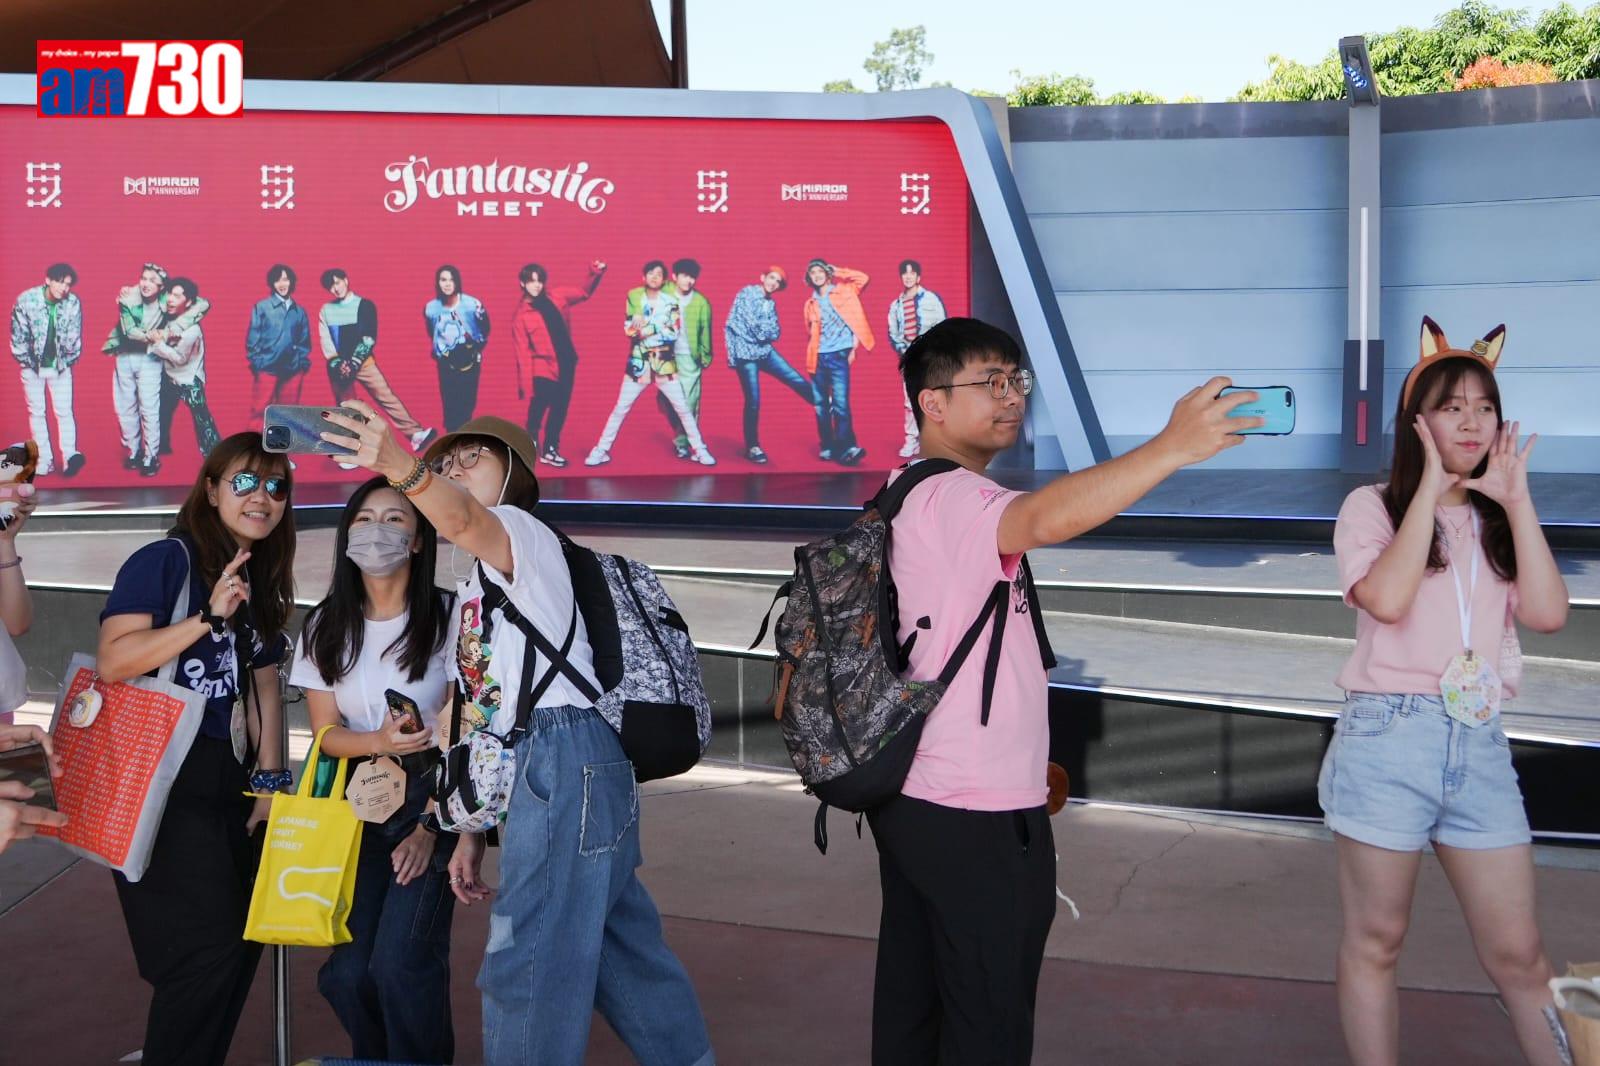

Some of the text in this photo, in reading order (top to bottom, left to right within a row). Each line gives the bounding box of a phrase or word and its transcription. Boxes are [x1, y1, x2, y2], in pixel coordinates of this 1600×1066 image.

[148, 177, 200, 187] MIRROR
[383, 154, 615, 214] Fantastic
[803, 184, 848, 193] MIRROR
[457, 201, 543, 217] MEET
